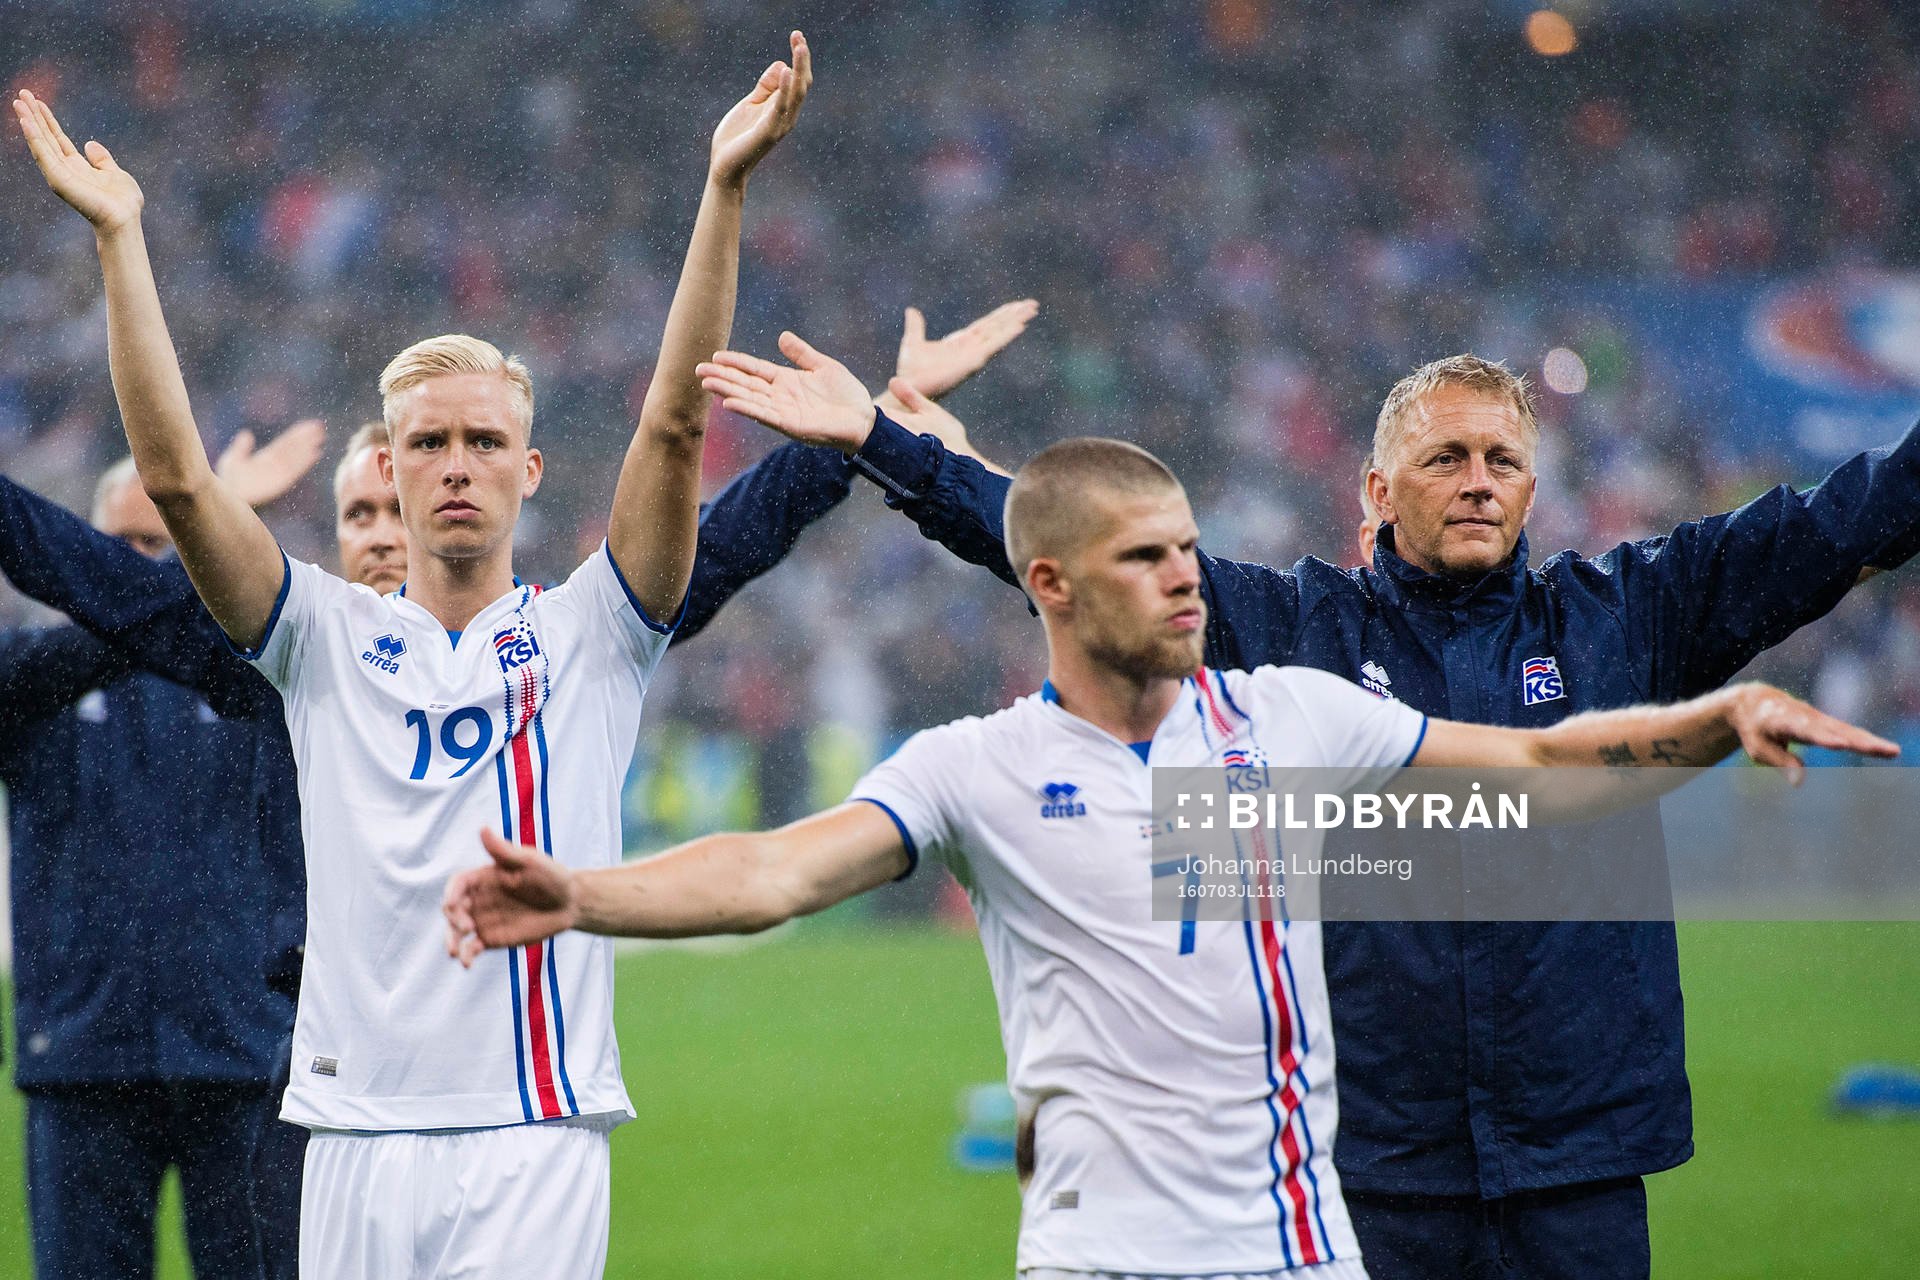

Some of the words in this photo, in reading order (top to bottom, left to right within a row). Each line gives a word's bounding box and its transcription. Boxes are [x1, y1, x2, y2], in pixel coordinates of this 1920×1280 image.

[362, 650, 400, 675] errea
[405, 706, 493, 780] 19
[1151, 855, 1199, 955] 7
